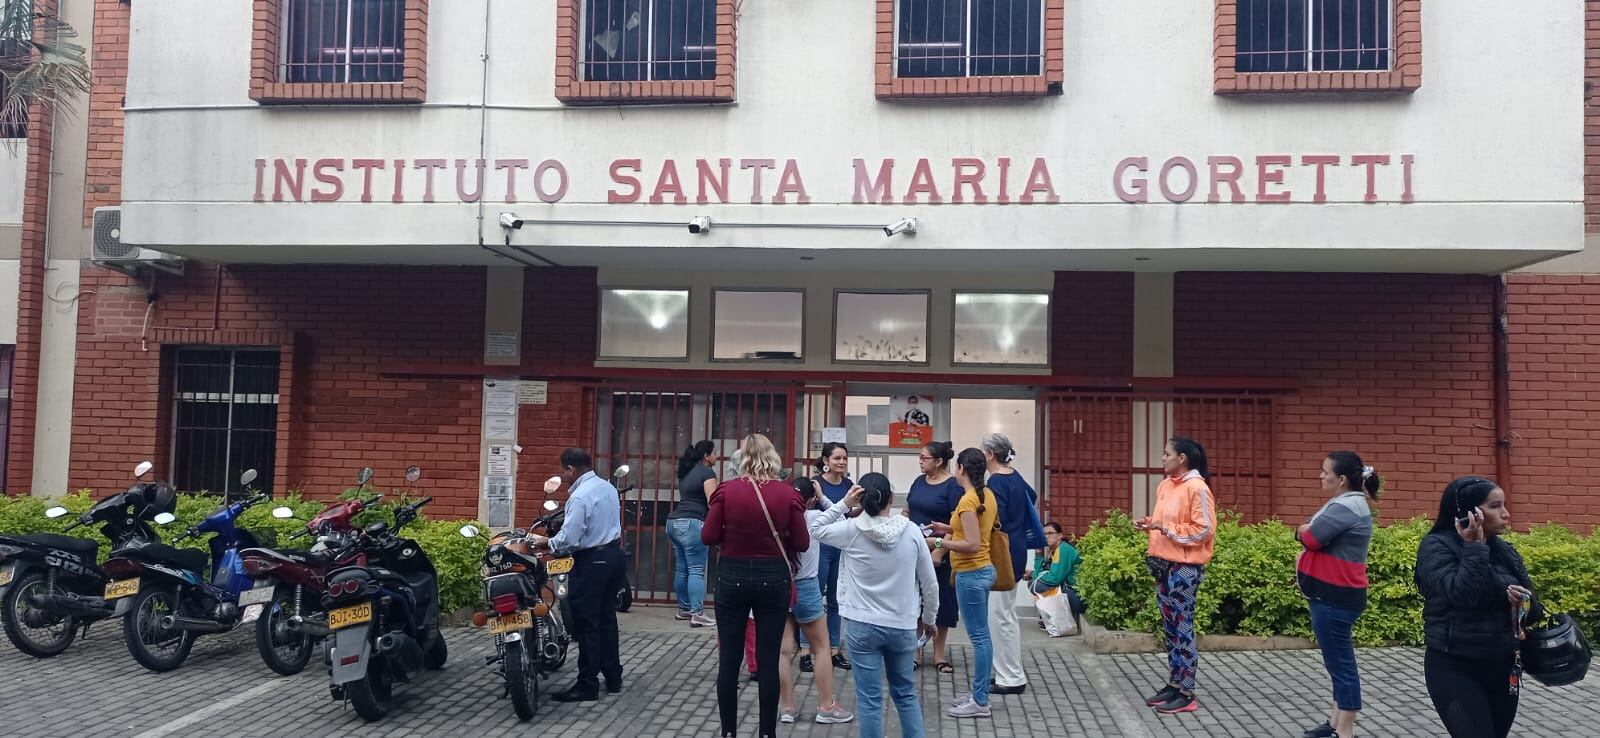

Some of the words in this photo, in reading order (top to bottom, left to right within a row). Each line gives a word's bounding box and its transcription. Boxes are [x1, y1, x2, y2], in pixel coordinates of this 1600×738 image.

[252, 158, 568, 203] INSTITUTO
[606, 158, 811, 204] SANTA
[852, 157, 1060, 204] MARIA
[1112, 154, 1415, 204] GORETTI
